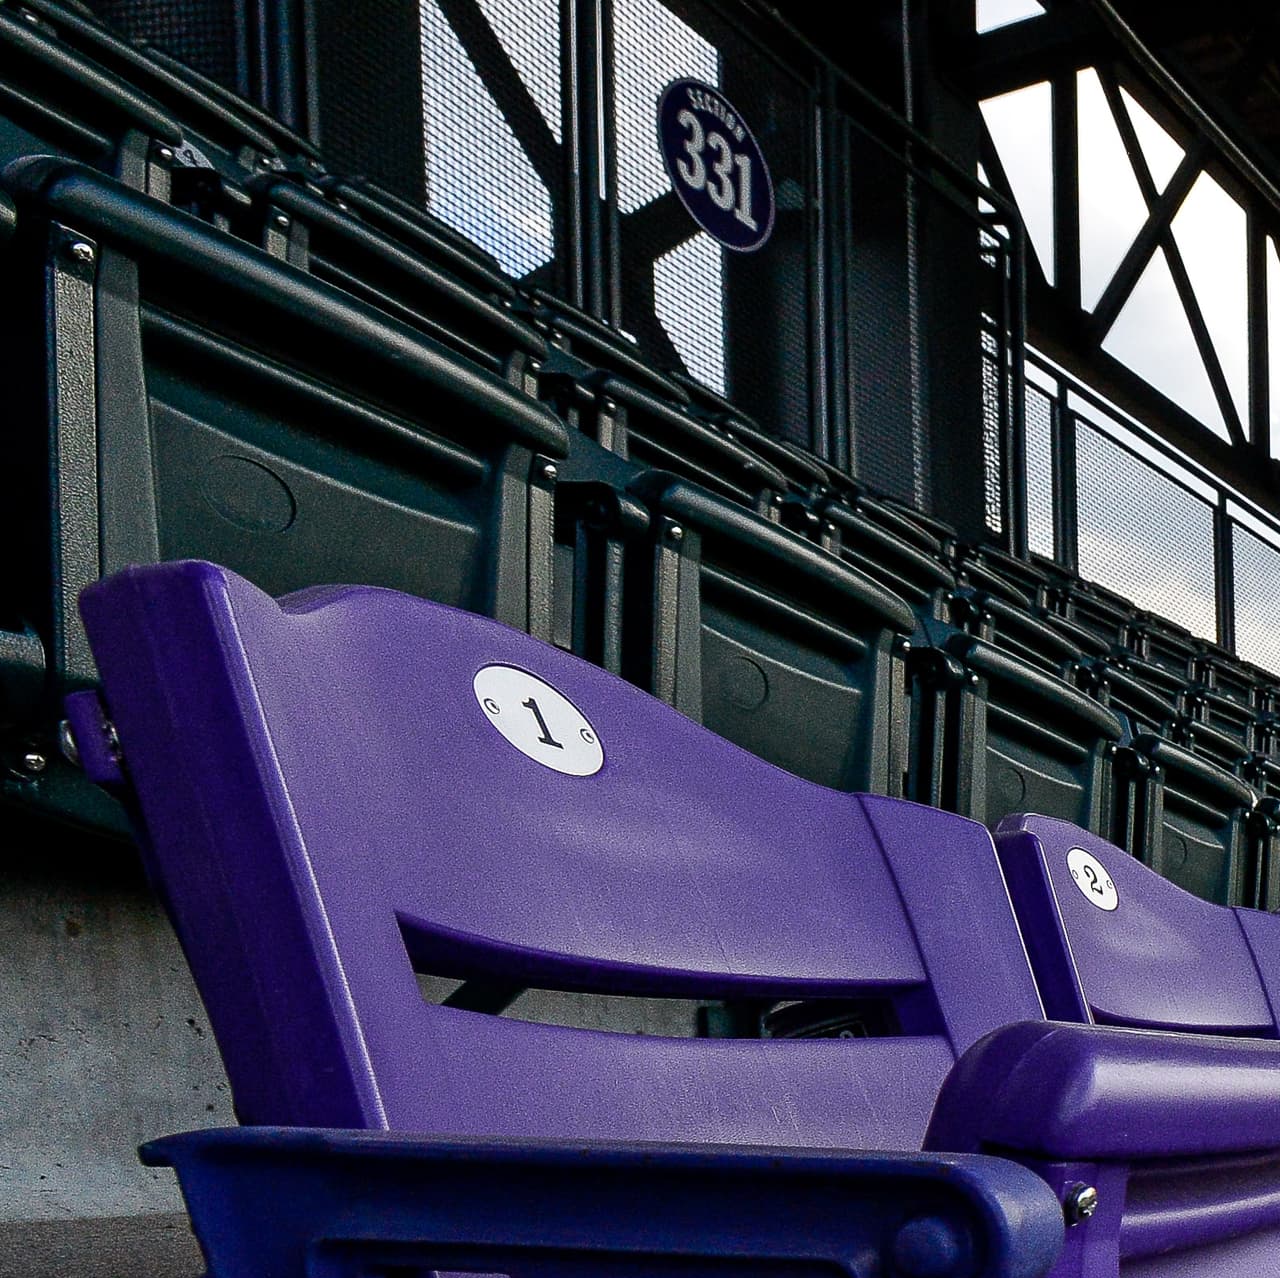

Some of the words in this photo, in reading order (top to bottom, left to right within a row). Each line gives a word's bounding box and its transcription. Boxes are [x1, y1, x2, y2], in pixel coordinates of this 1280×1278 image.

[686, 87, 747, 142] SECTION
[676, 109, 759, 232] 331
[521, 696, 565, 750] 1
[1082, 864, 1105, 897] 2
